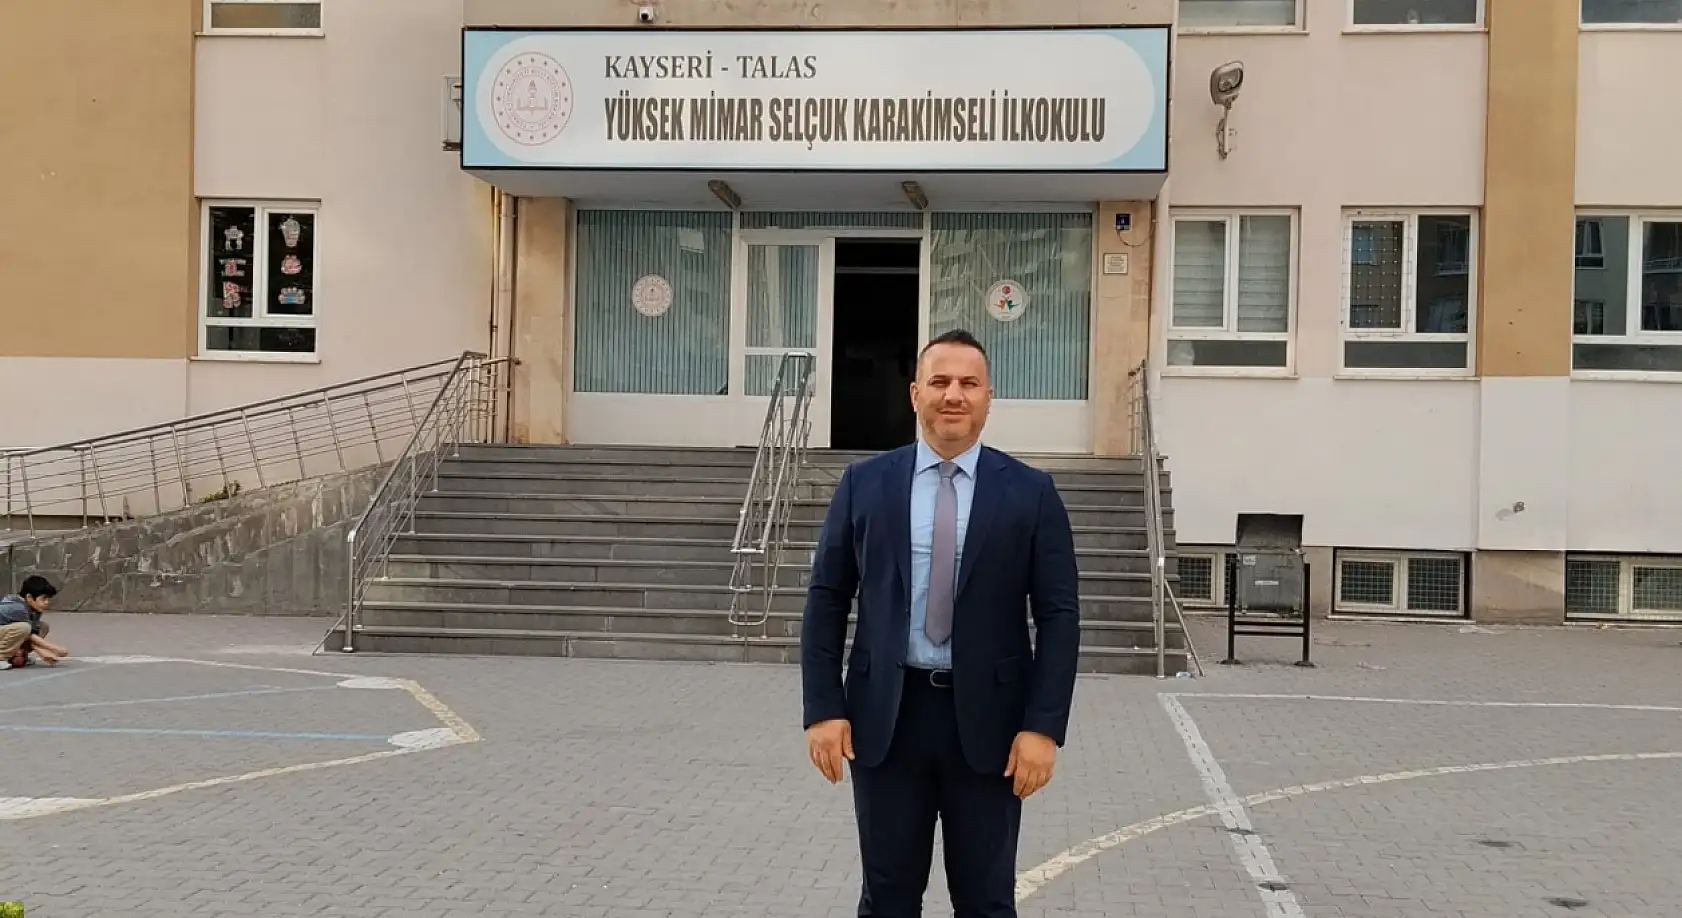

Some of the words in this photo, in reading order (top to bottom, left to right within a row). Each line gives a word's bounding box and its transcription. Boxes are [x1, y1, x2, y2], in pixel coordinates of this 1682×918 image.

[604, 49, 713, 79] KAYSERİ
[736, 55, 817, 79] TALAS
[604, 89, 685, 142] YÜKSEK
[690, 90, 764, 141] MİMAR
[768, 97, 848, 151] SELÇUK
[853, 89, 997, 143] KARAKİMSELİ
[1002, 89, 1106, 143] İLKOKULU
